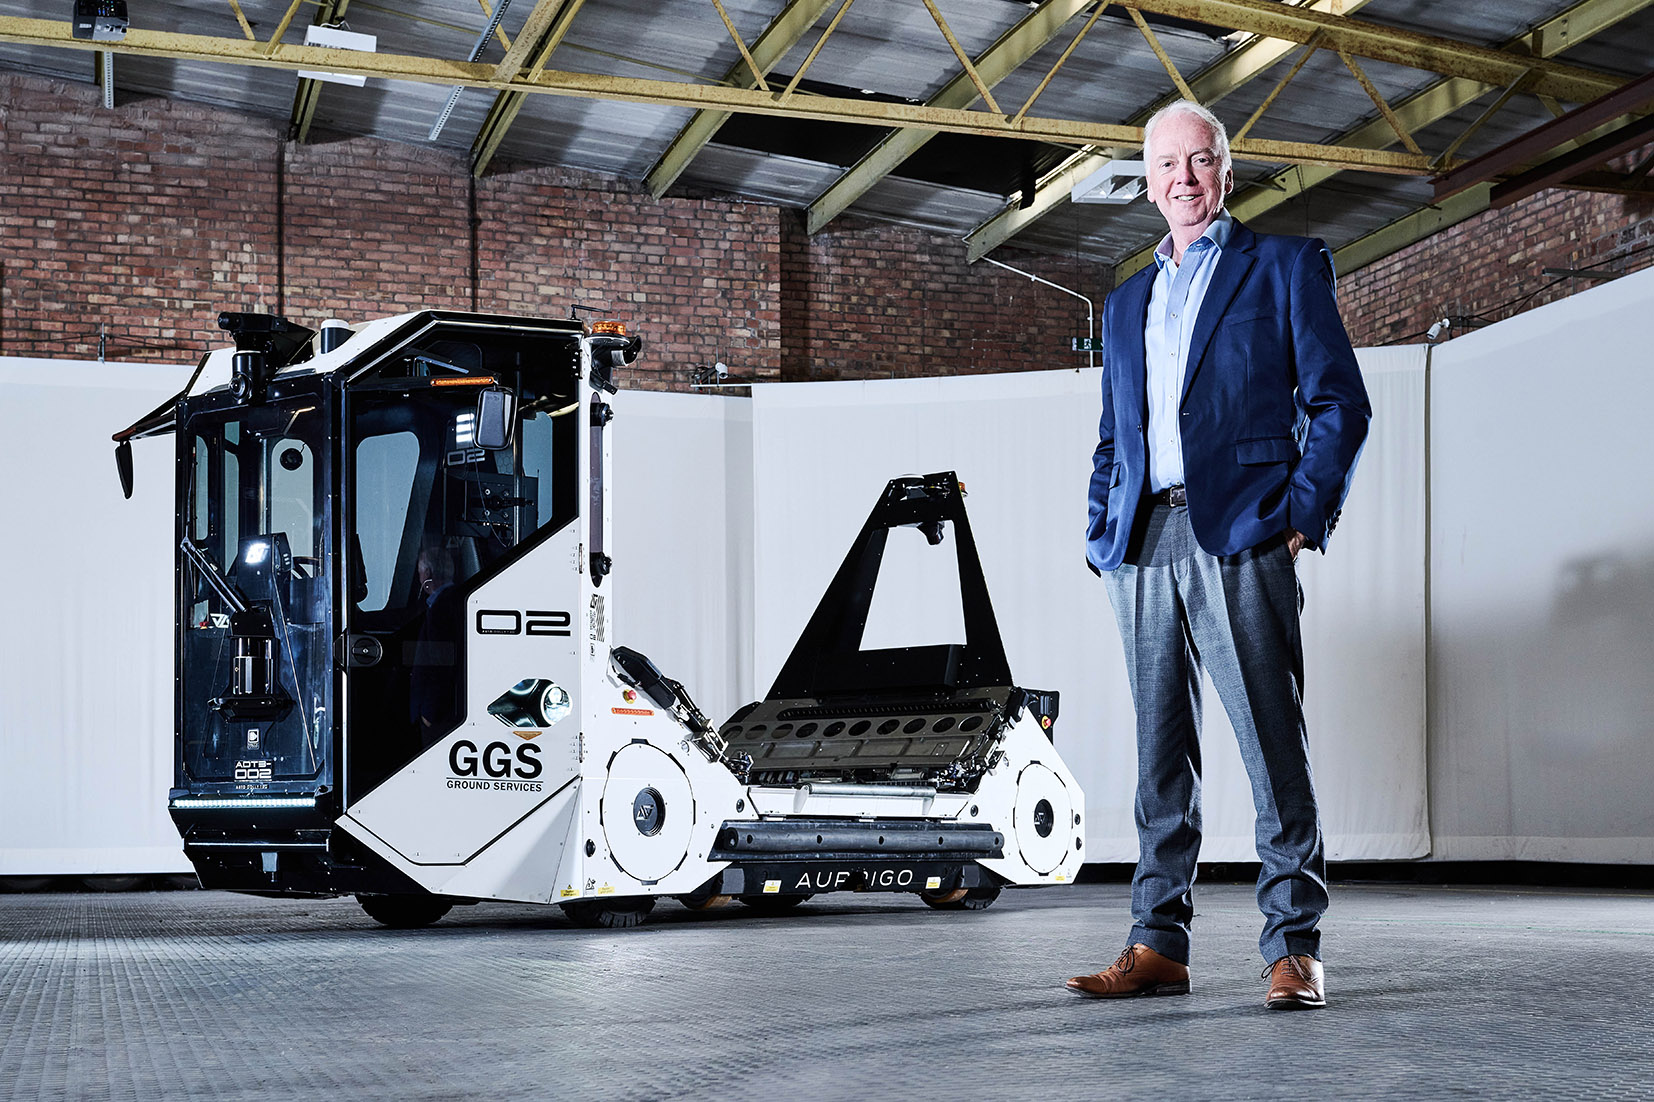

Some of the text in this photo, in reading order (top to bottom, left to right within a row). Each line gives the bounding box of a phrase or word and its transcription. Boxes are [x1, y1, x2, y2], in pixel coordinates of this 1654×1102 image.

[476, 609, 571, 636] 02
[449, 740, 543, 779] GGS
[234, 768, 272, 779] 002
[446, 780, 542, 792] GROUND SERVICES
[795, 869, 914, 888] AURIGO
